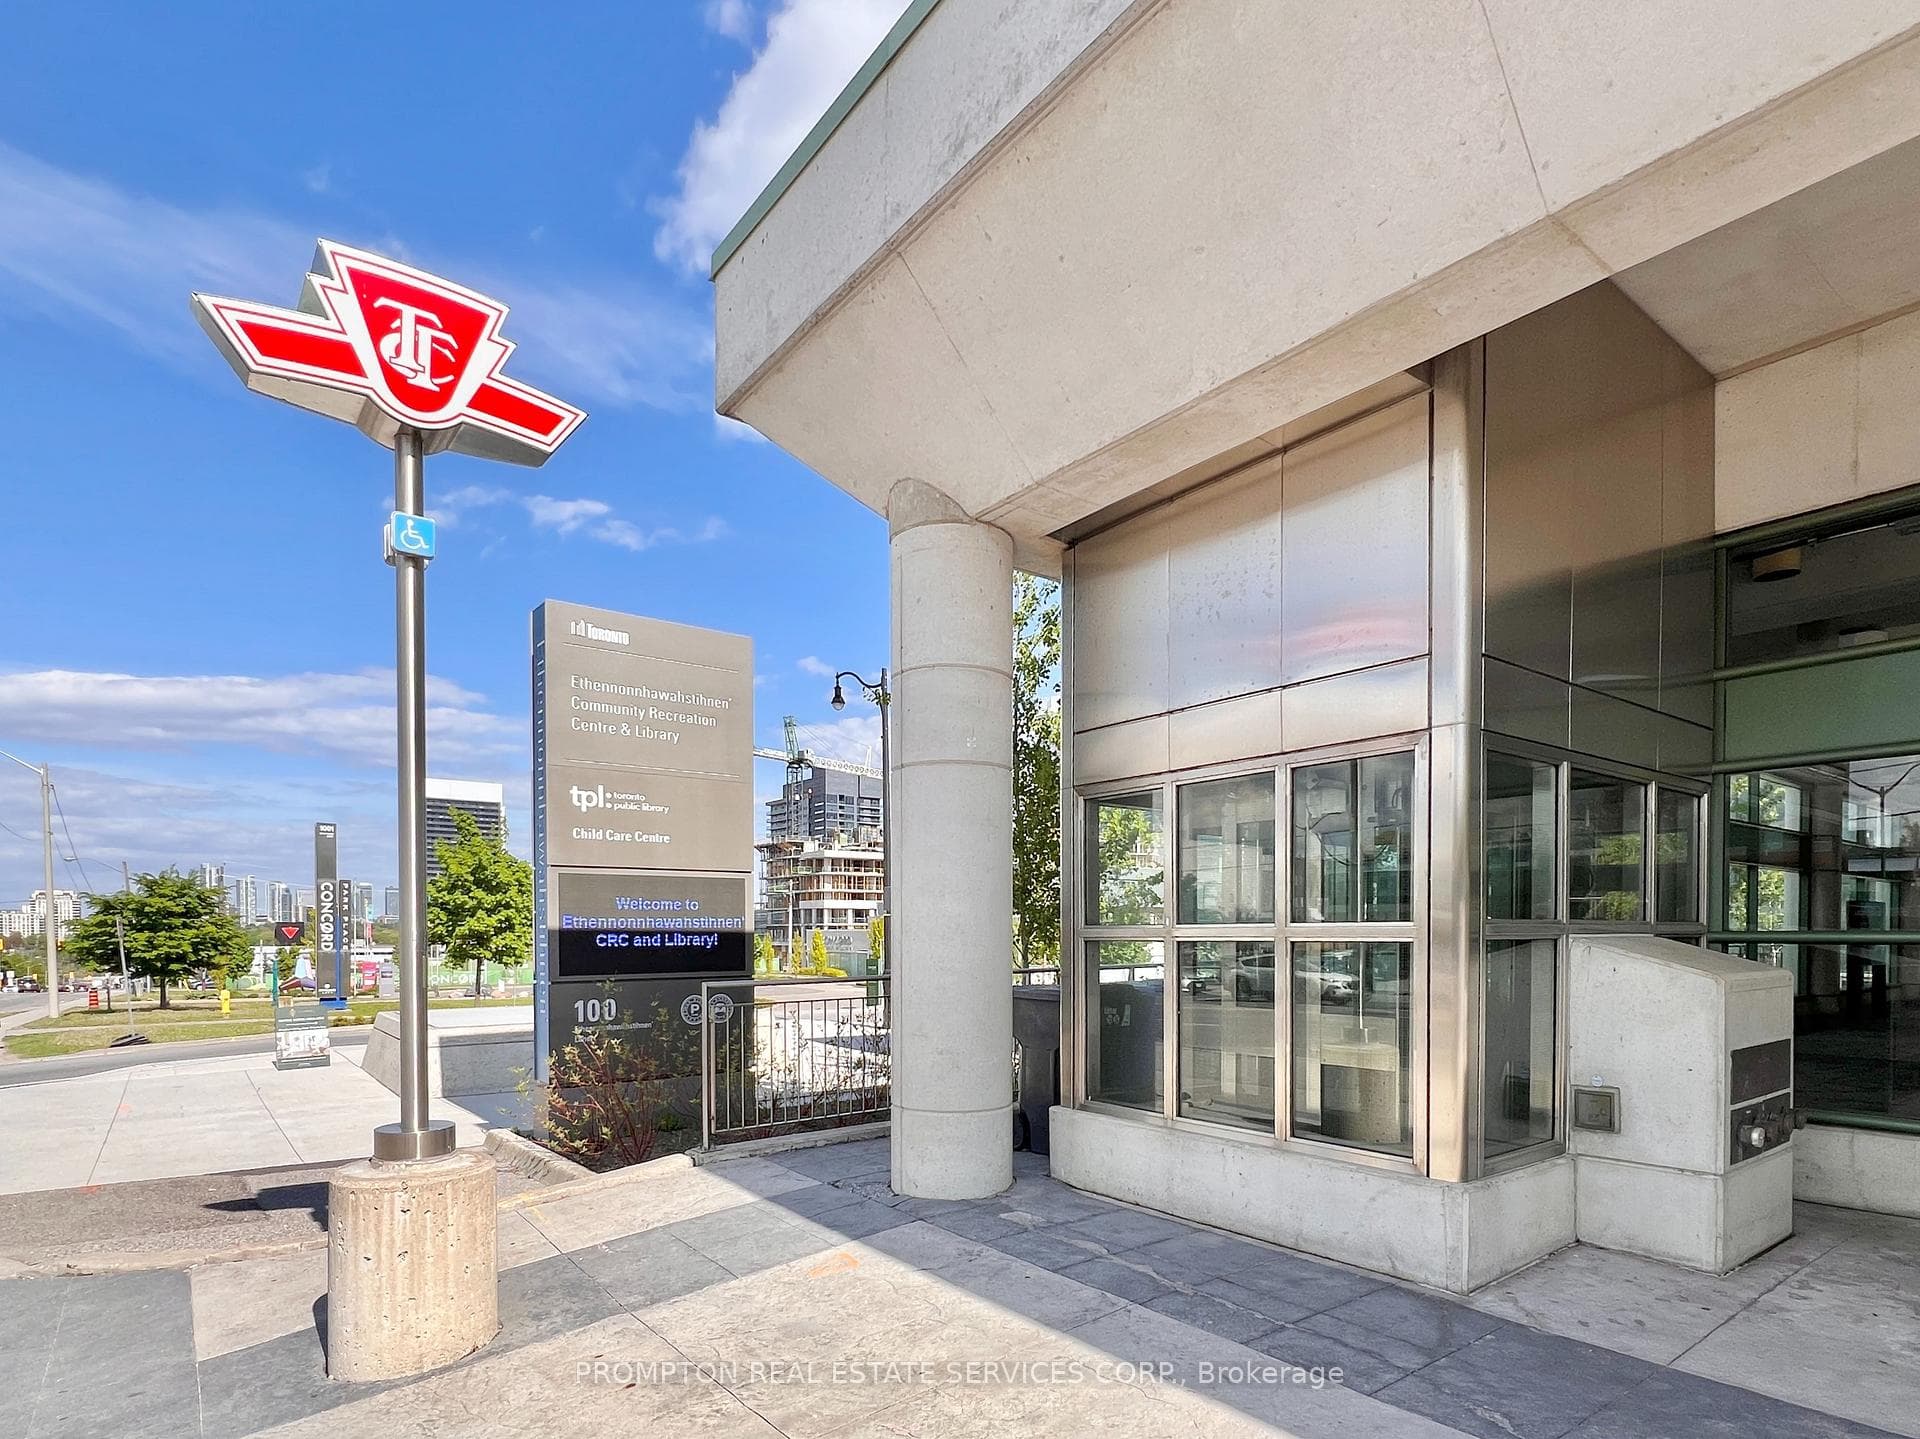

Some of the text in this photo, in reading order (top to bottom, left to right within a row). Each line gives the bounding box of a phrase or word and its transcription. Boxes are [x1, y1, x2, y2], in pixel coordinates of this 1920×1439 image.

[586, 623, 630, 646] TORONTO
[571, 696, 718, 727] Community Recreation
[571, 717, 681, 745] Centre & Library
[569, 784, 605, 813] tpl
[613, 791, 646, 801] toronto
[613, 801, 670, 815] public library
[572, 827, 671, 844] Child Care Centre
[615, 896, 699, 911] Welcome to
[596, 933, 719, 949] CRC and Library!
[574, 998, 617, 1023] 100
